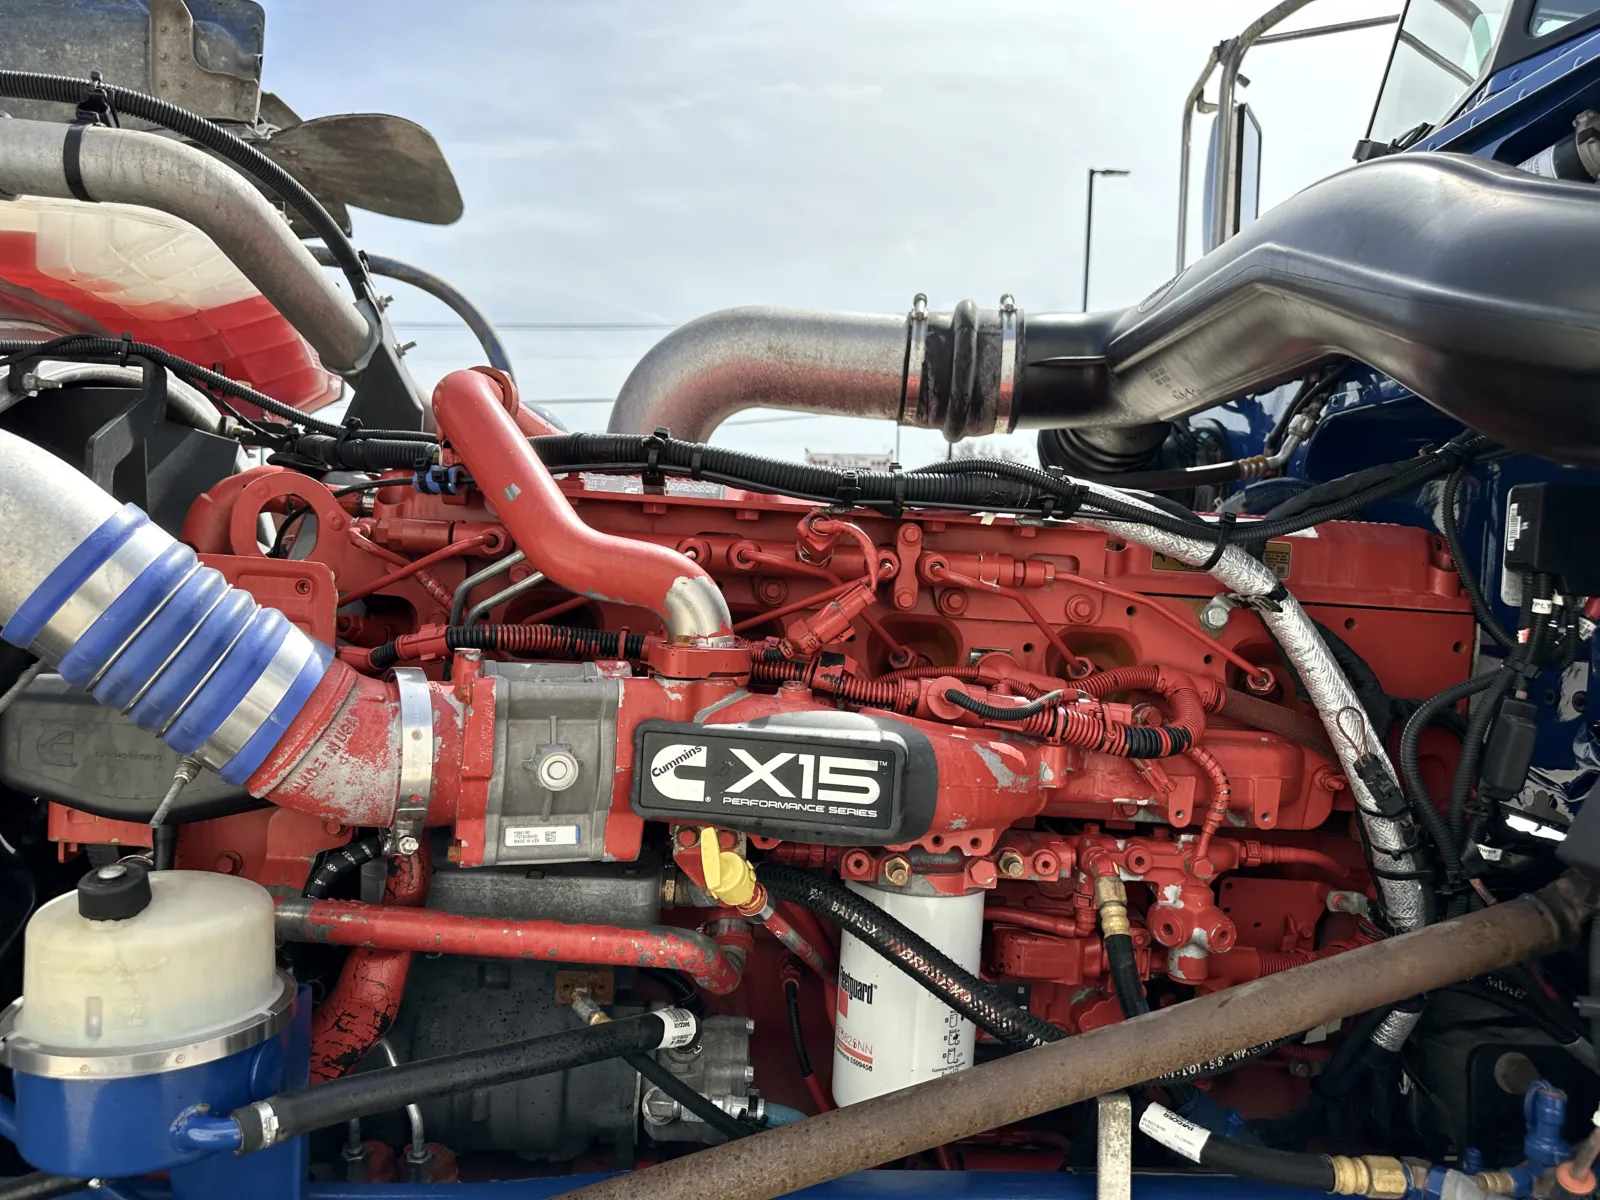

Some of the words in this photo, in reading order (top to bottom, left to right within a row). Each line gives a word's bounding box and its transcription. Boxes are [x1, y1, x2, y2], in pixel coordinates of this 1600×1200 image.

[334, 715, 359, 744] USA
[652, 745, 702, 778] Cummins
[723, 797, 825, 813] PERFORMANCE
[828, 806, 878, 818] SERIES
[831, 901, 879, 937] BALFLEX
[1163, 1112, 1194, 1132] PACCAR
